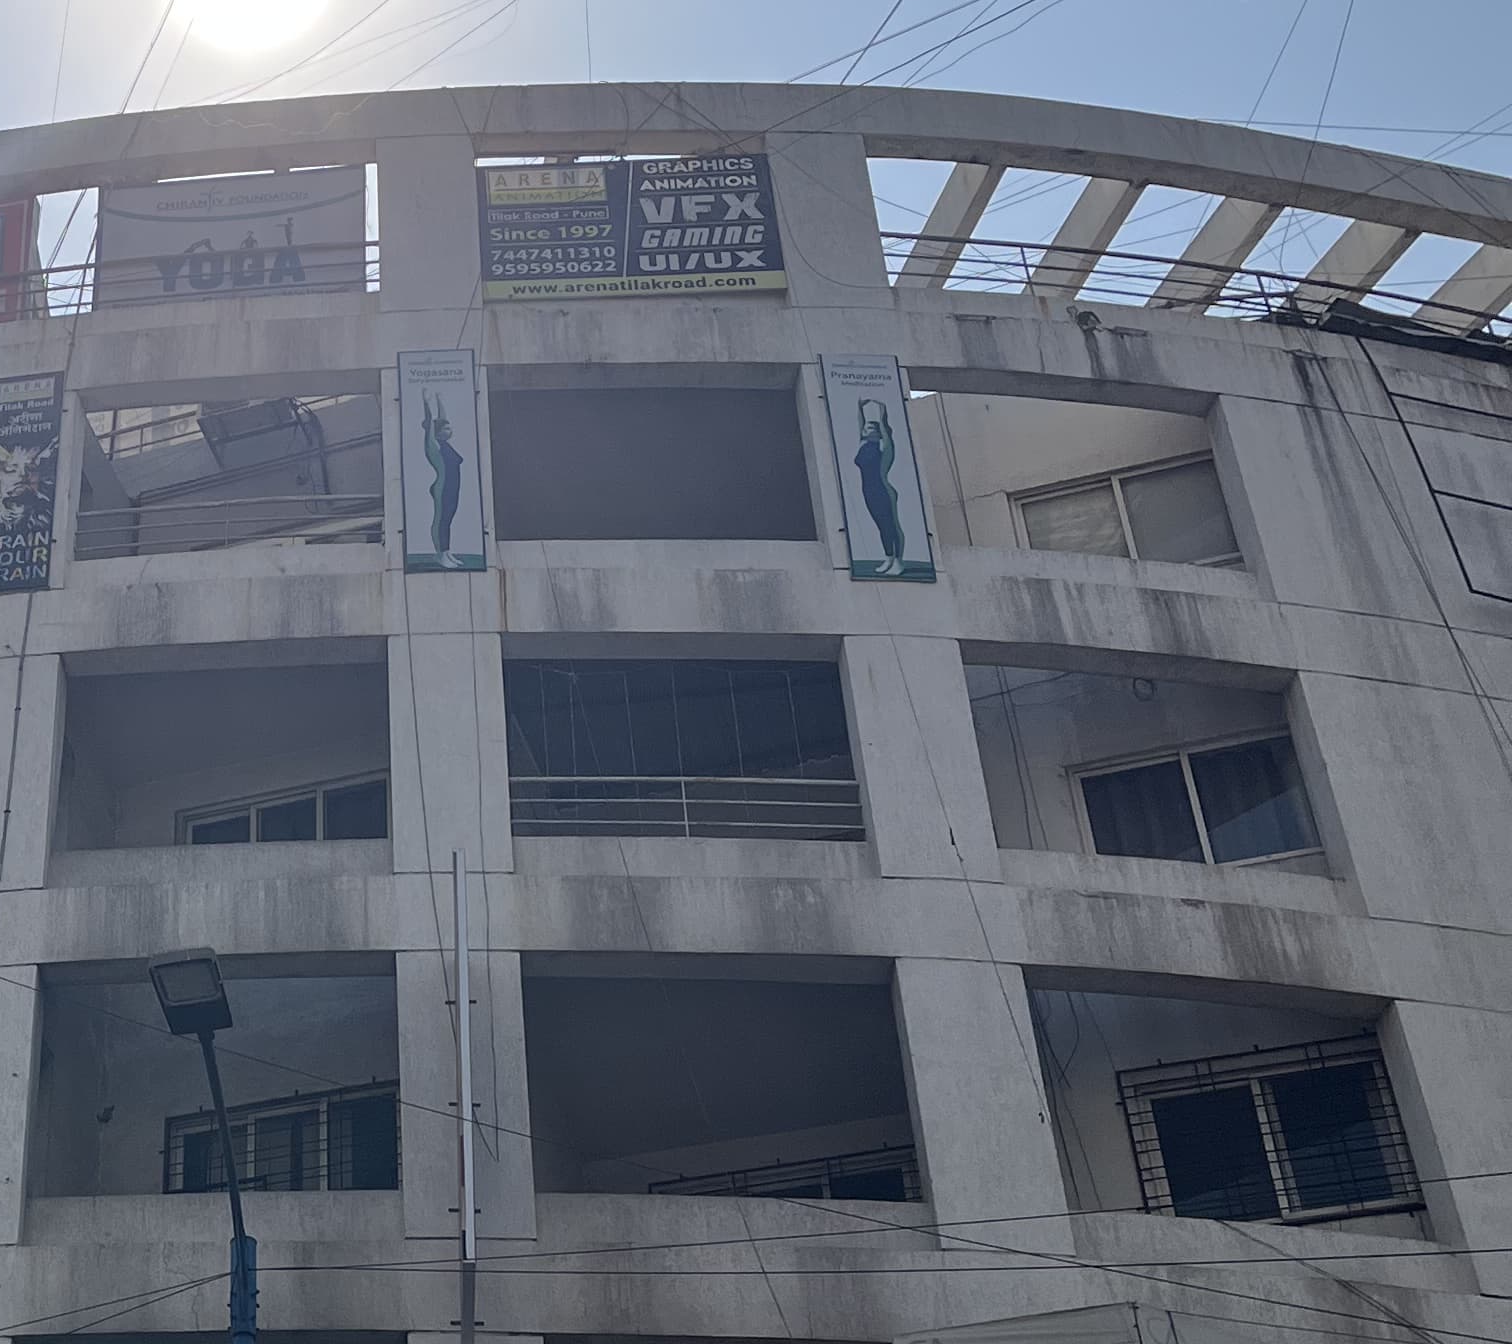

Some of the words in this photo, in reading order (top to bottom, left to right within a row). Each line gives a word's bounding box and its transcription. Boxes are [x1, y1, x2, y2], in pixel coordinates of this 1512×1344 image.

[642, 158, 754, 175] GRAPHICS
[493, 169, 601, 188] ARENA
[639, 175, 758, 192] ANIMATION
[639, 192, 764, 223] VFX
[490, 227, 550, 241] Since
[559, 225, 612, 239] 1997
[641, 225, 765, 248] GAMING
[492, 247, 616, 261] 7447411310
[639, 249, 767, 271] UI/UX
[154, 246, 306, 293] YOGA
[492, 260, 617, 275] 9595950622
[512, 275, 756, 296] www.arenatilakroad.com
